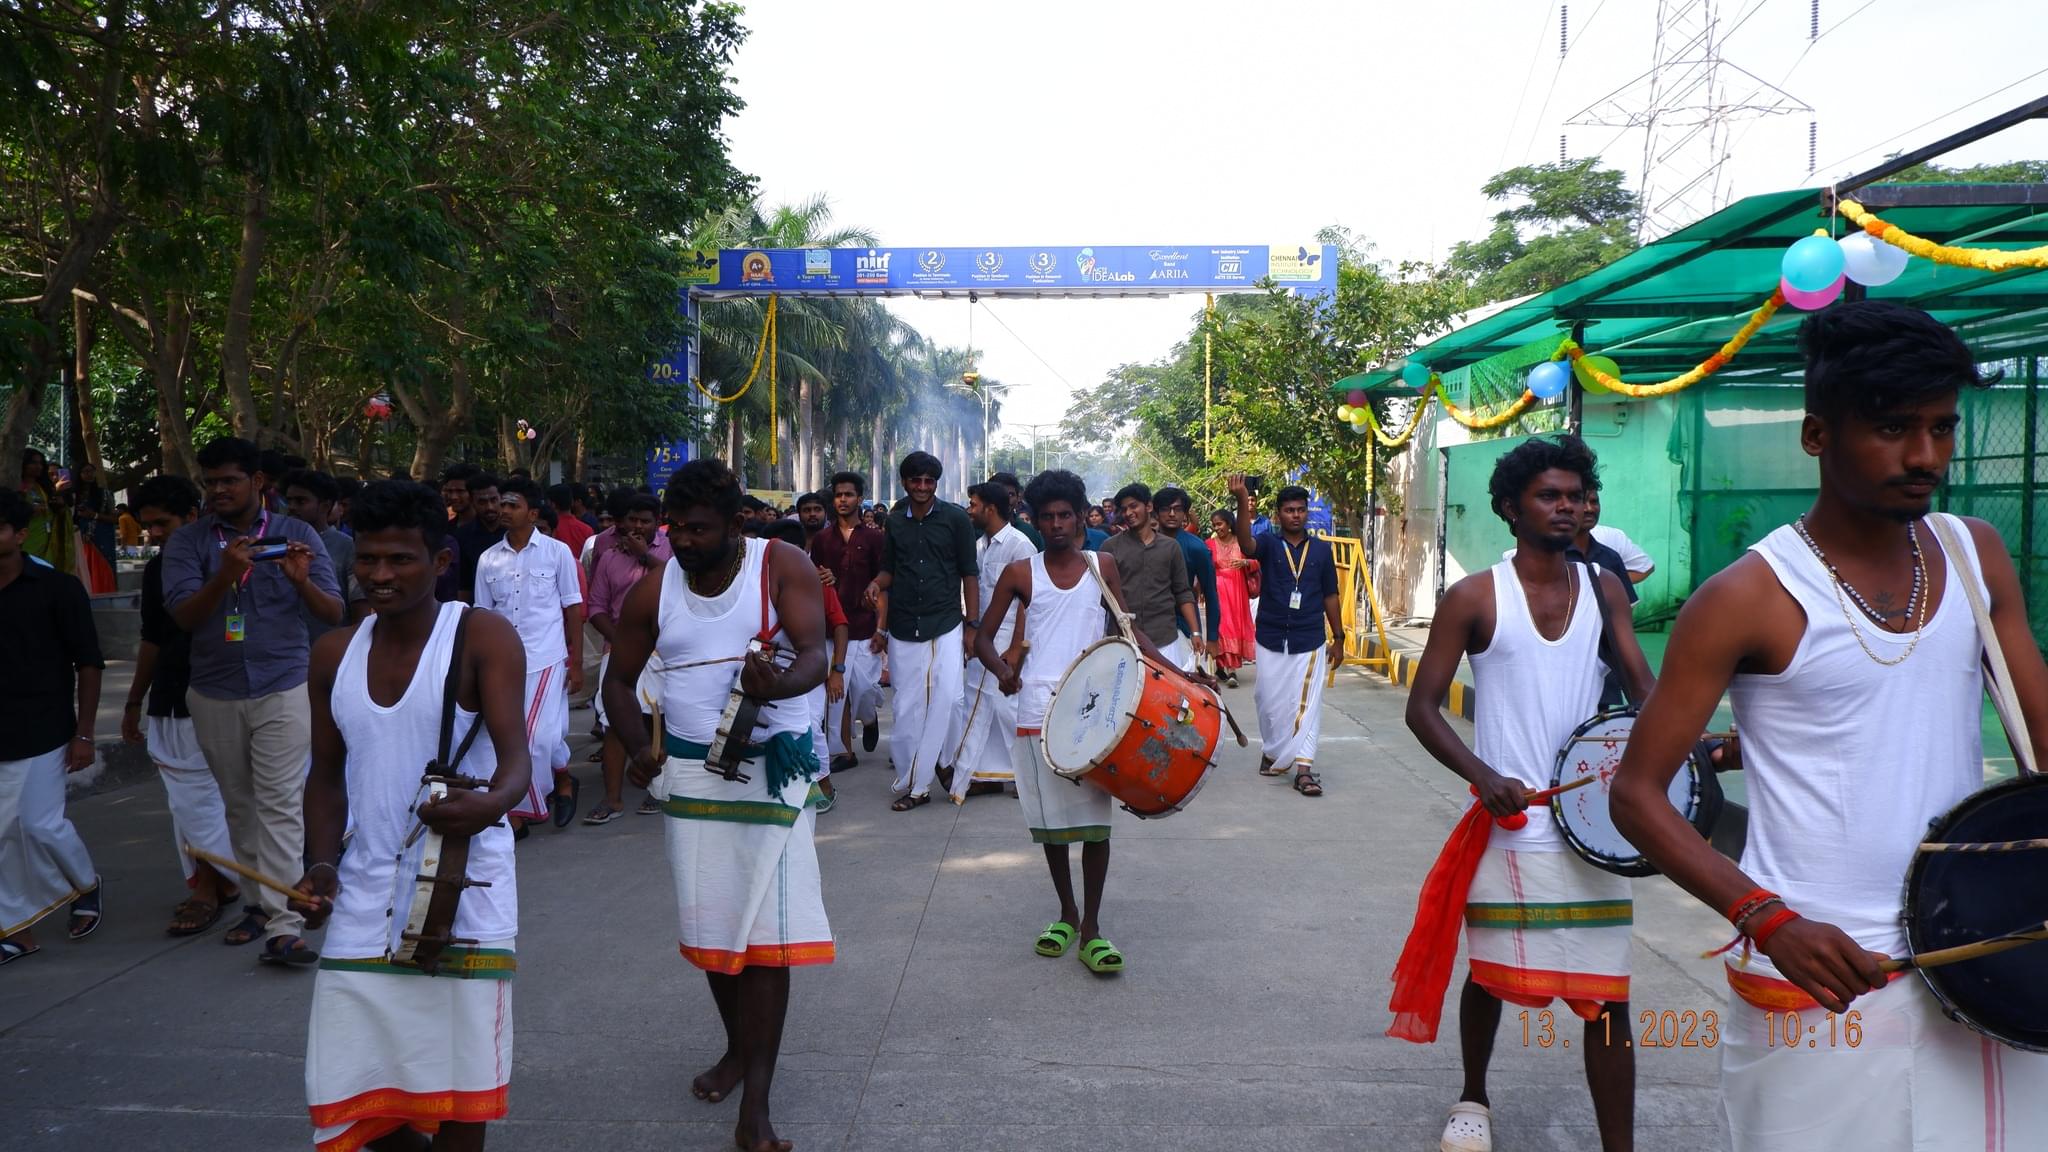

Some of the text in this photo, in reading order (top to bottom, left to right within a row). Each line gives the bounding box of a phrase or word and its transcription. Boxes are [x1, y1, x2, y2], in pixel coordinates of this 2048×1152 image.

[856, 249, 892, 269] nirf
[927, 251, 938, 265] 2
[985, 252, 995, 266] 3
[1038, 252, 1048, 266] 3
[1148, 250, 1188, 261] Excellent
[1221, 263, 1239, 273] CII
[653, 363, 680, 379] 20+
[653, 447, 680, 463] 75+
